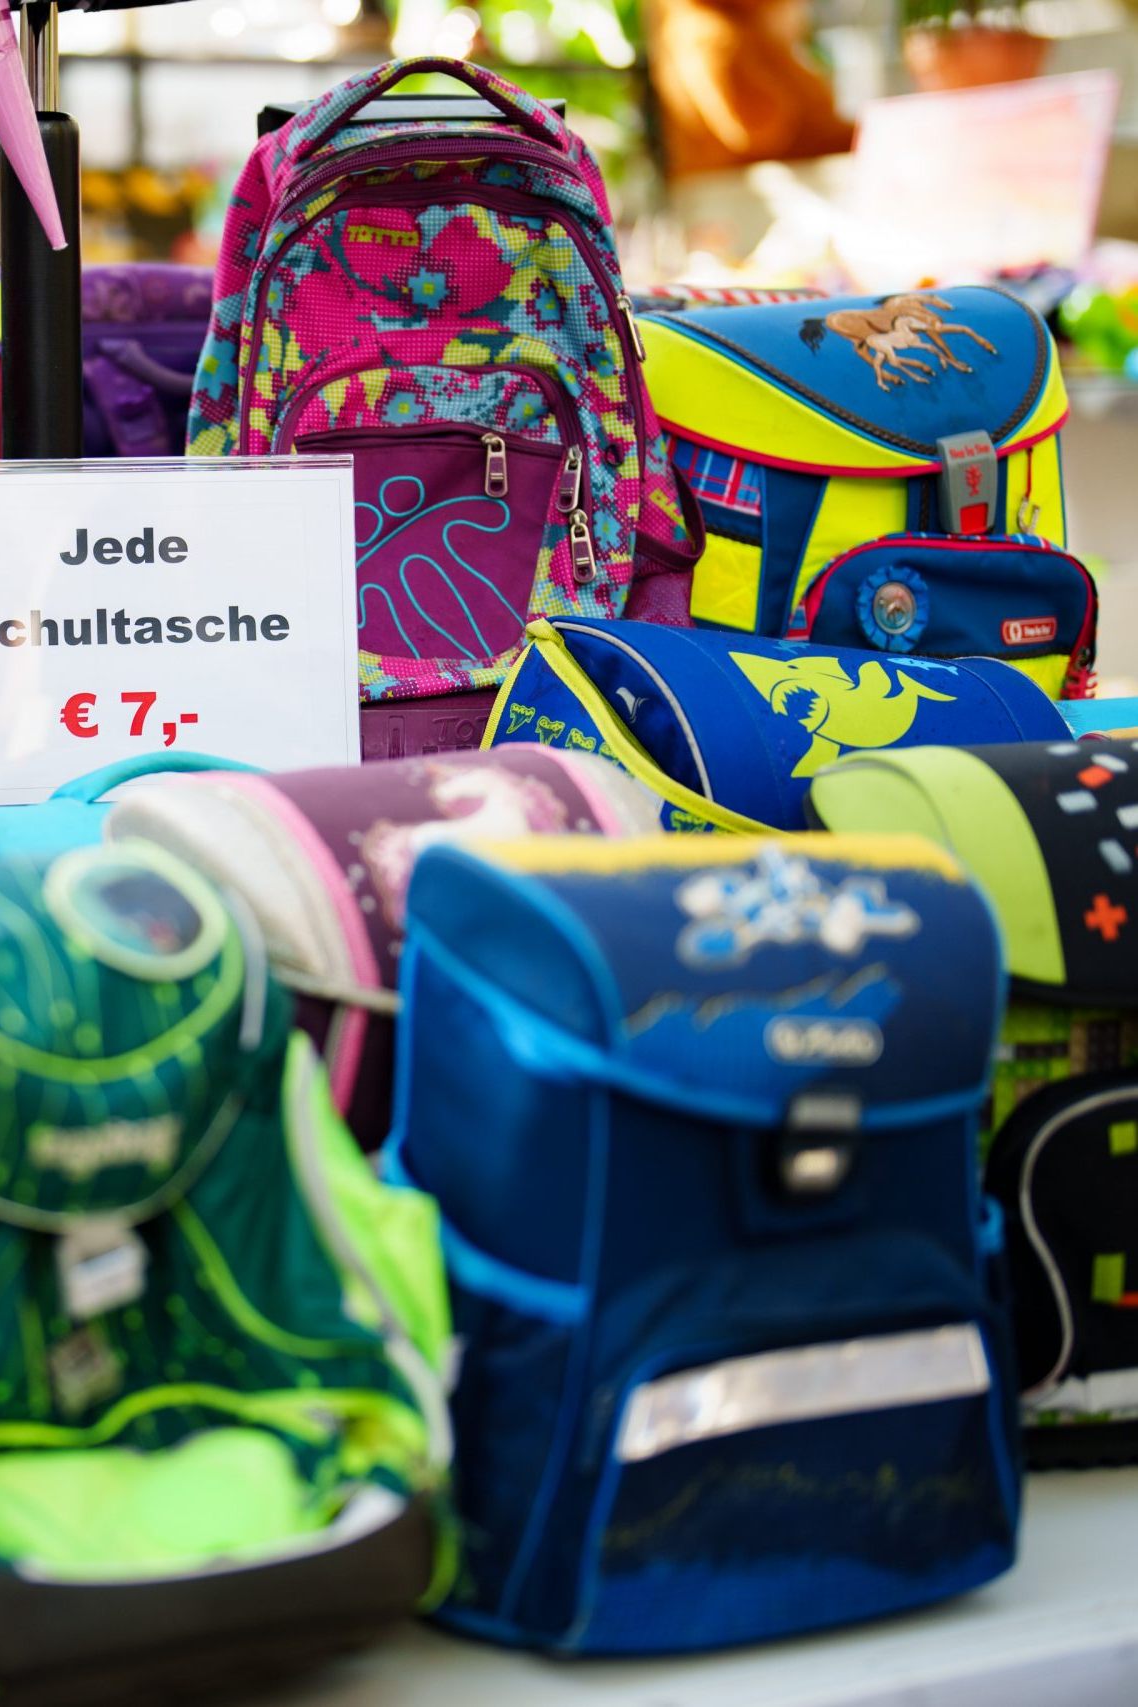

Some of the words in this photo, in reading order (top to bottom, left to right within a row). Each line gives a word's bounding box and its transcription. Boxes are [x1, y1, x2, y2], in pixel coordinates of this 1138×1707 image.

[59, 527, 189, 566] Jede
[59, 692, 99, 738] €
[121, 691, 199, 747] 7,-
